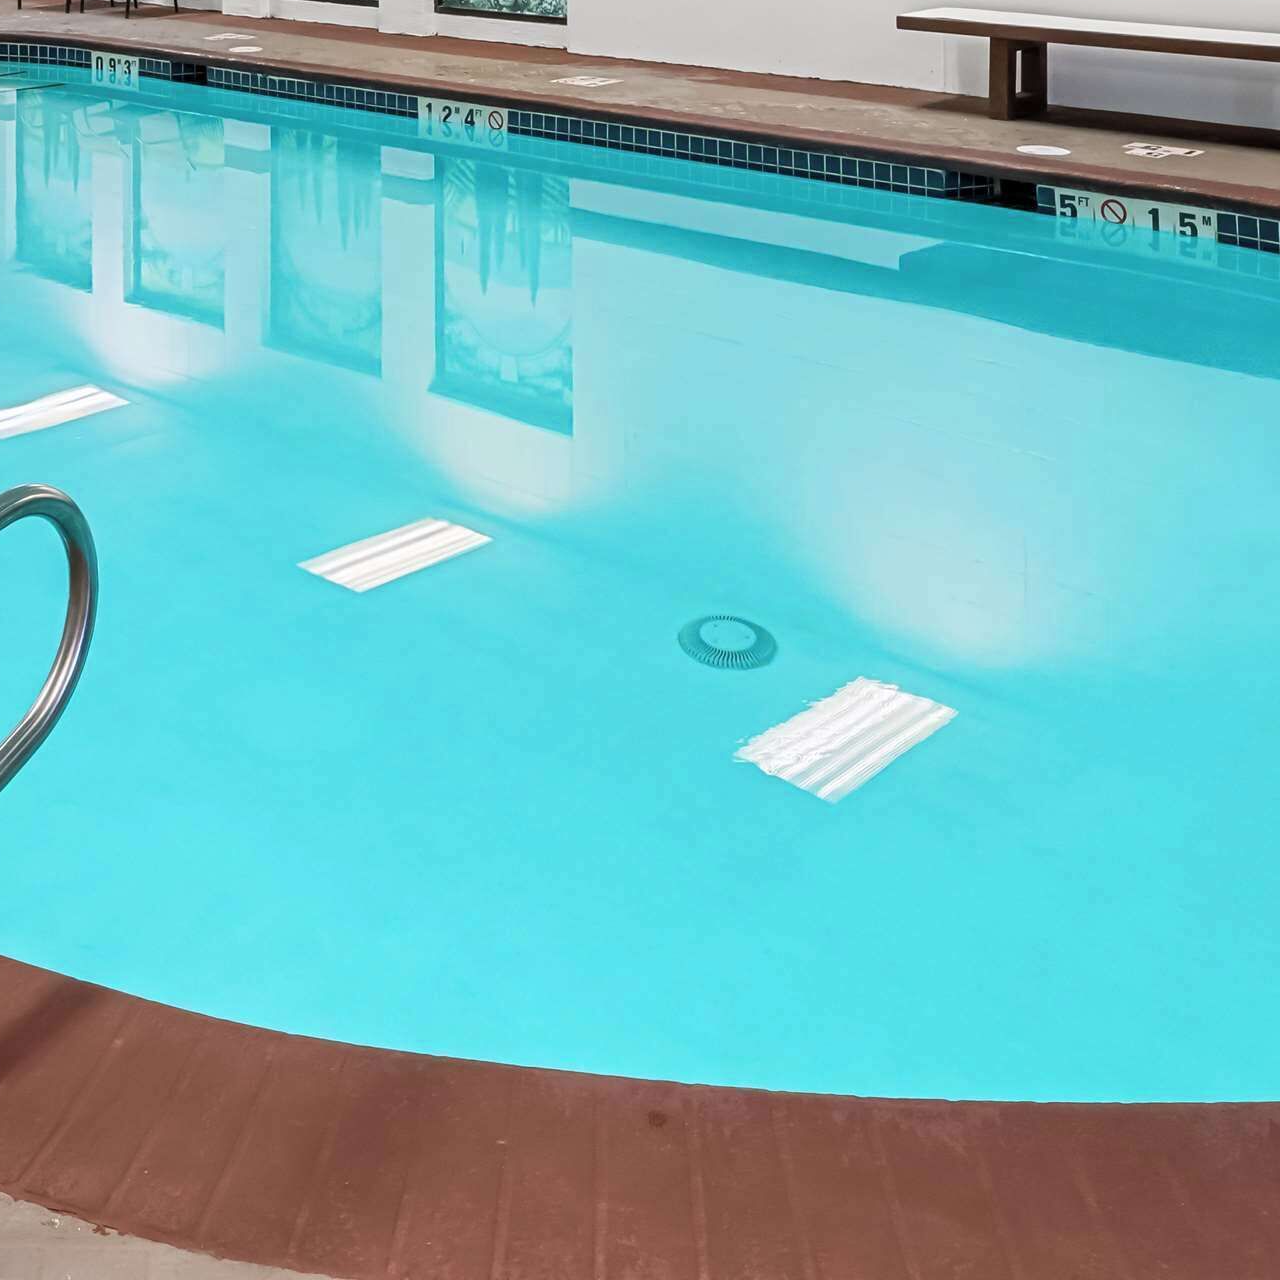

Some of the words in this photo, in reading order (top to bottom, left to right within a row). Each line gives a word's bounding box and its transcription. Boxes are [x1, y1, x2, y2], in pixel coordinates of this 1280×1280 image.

[109, 57, 116, 73] 9
[124, 60, 131, 75] 3
[442, 105, 452, 123] 2
[464, 108, 475, 126] 4
[1059, 194, 1077, 217] 5
[1078, 196, 1090, 207] FT
[1148, 208, 1160, 232] 1
[1179, 212, 1198, 237] 5
[1202, 216, 1212, 226] M
